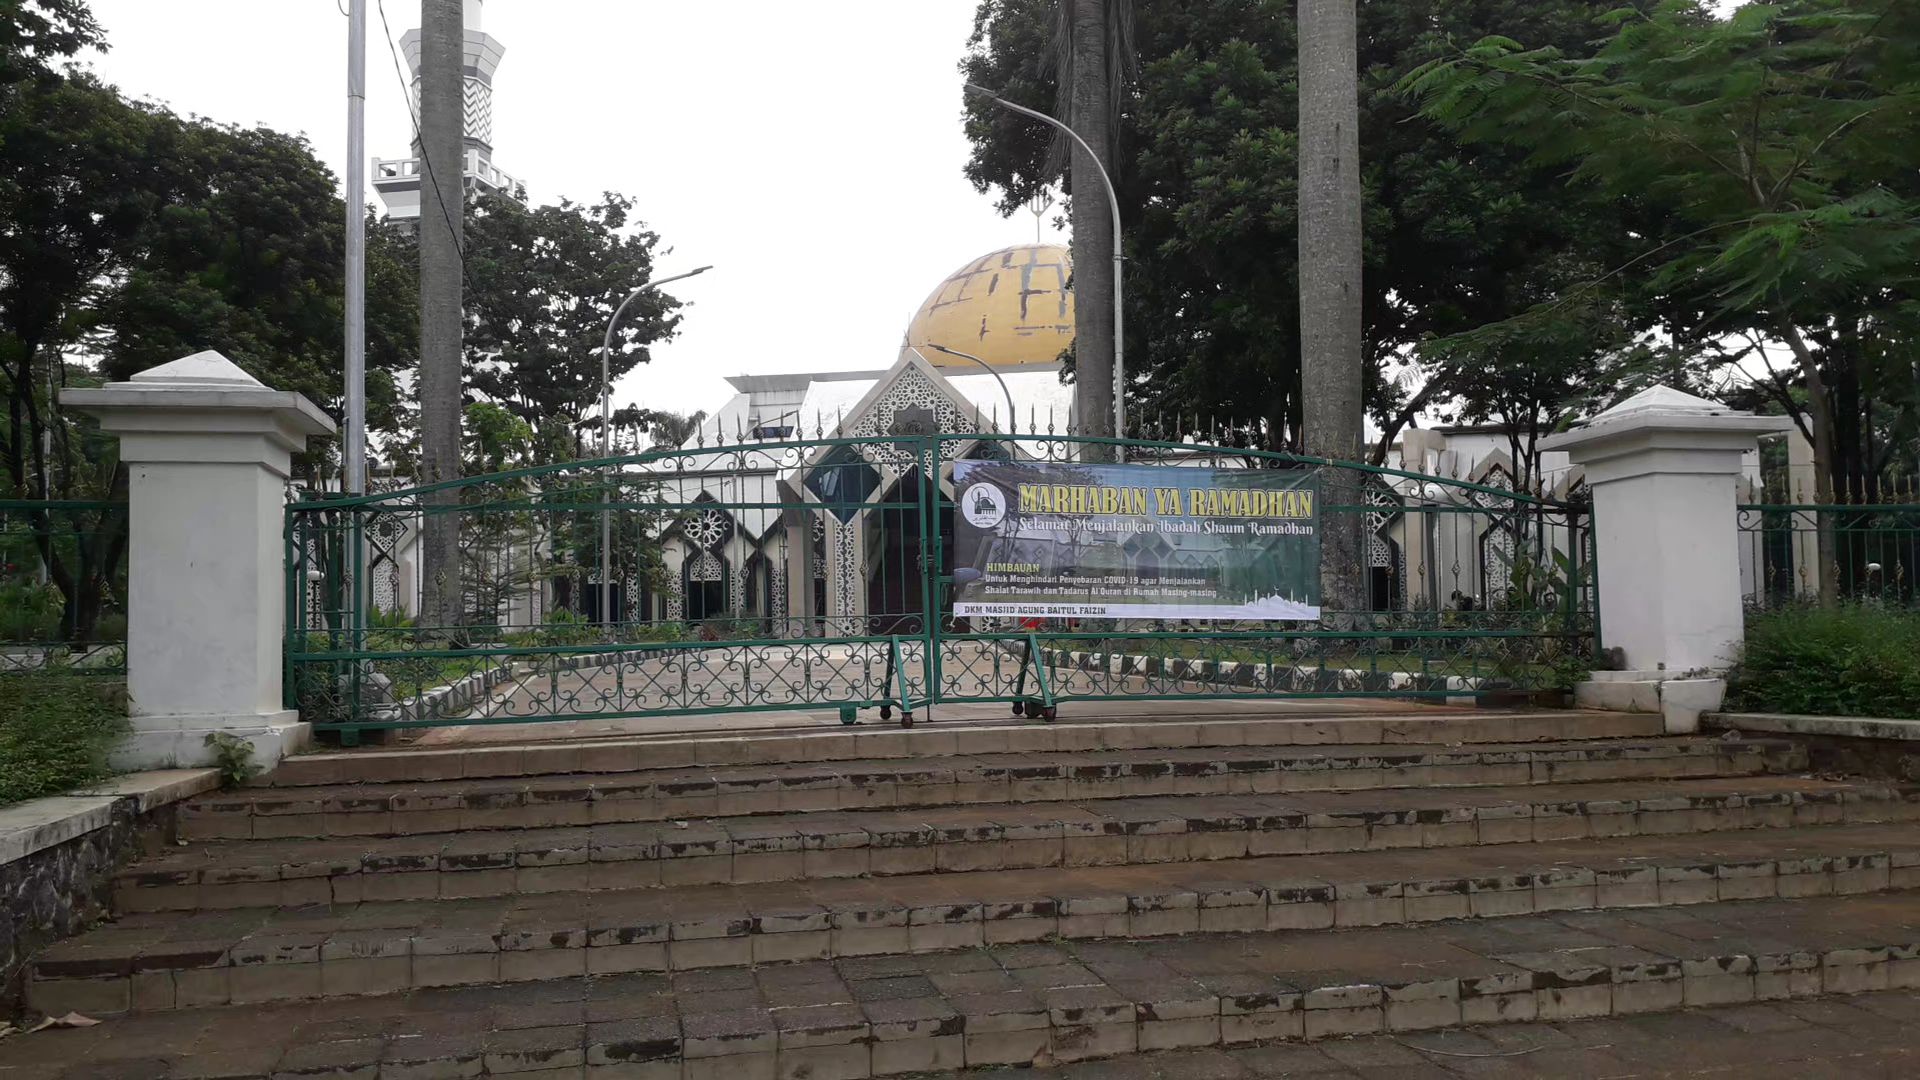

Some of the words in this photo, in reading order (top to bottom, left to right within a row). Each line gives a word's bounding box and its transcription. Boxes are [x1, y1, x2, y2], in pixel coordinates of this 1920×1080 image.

[1018, 484, 1148, 516] MARHABAN
[1154, 487, 1184, 517] YA
[1189, 487, 1313, 518] RAMADHAN
[1018, 517, 1070, 531] Selamat
[1072, 518, 1154, 535] Menjalankan
[1157, 520, 1201, 534] Ibadah
[1202, 521, 1245, 535] Shaum
[1247, 522, 1313, 536] Ramadhan
[986, 562, 1040, 573] HIMBAUAN
[985, 574, 1008, 583] Untuk
[1009, 574, 1057, 584] Menghindari
[1104, 576, 1139, 585] COVID-19
[1140, 577, 1157, 586] agar
[1158, 576, 1206, 587] Menjalankan
[985, 585, 1010, 594] Shalat
[1010, 586, 1042, 595] Tarawih
[1043, 586, 1058, 595] dan
[1059, 586, 1089, 595] Tadarus
[1123, 587, 1131, 596] di
[1133, 587, 1159, 597] Rumah
[1161, 588, 1217, 599] Masing-masing
[964, 605, 983, 614] DKM
[985, 605, 1015, 614] MASJID
[1017, 605, 1045, 615] AGUNG
[1047, 606, 1077, 615] BAITUL
[1079, 606, 1106, 615] FAIZIN
